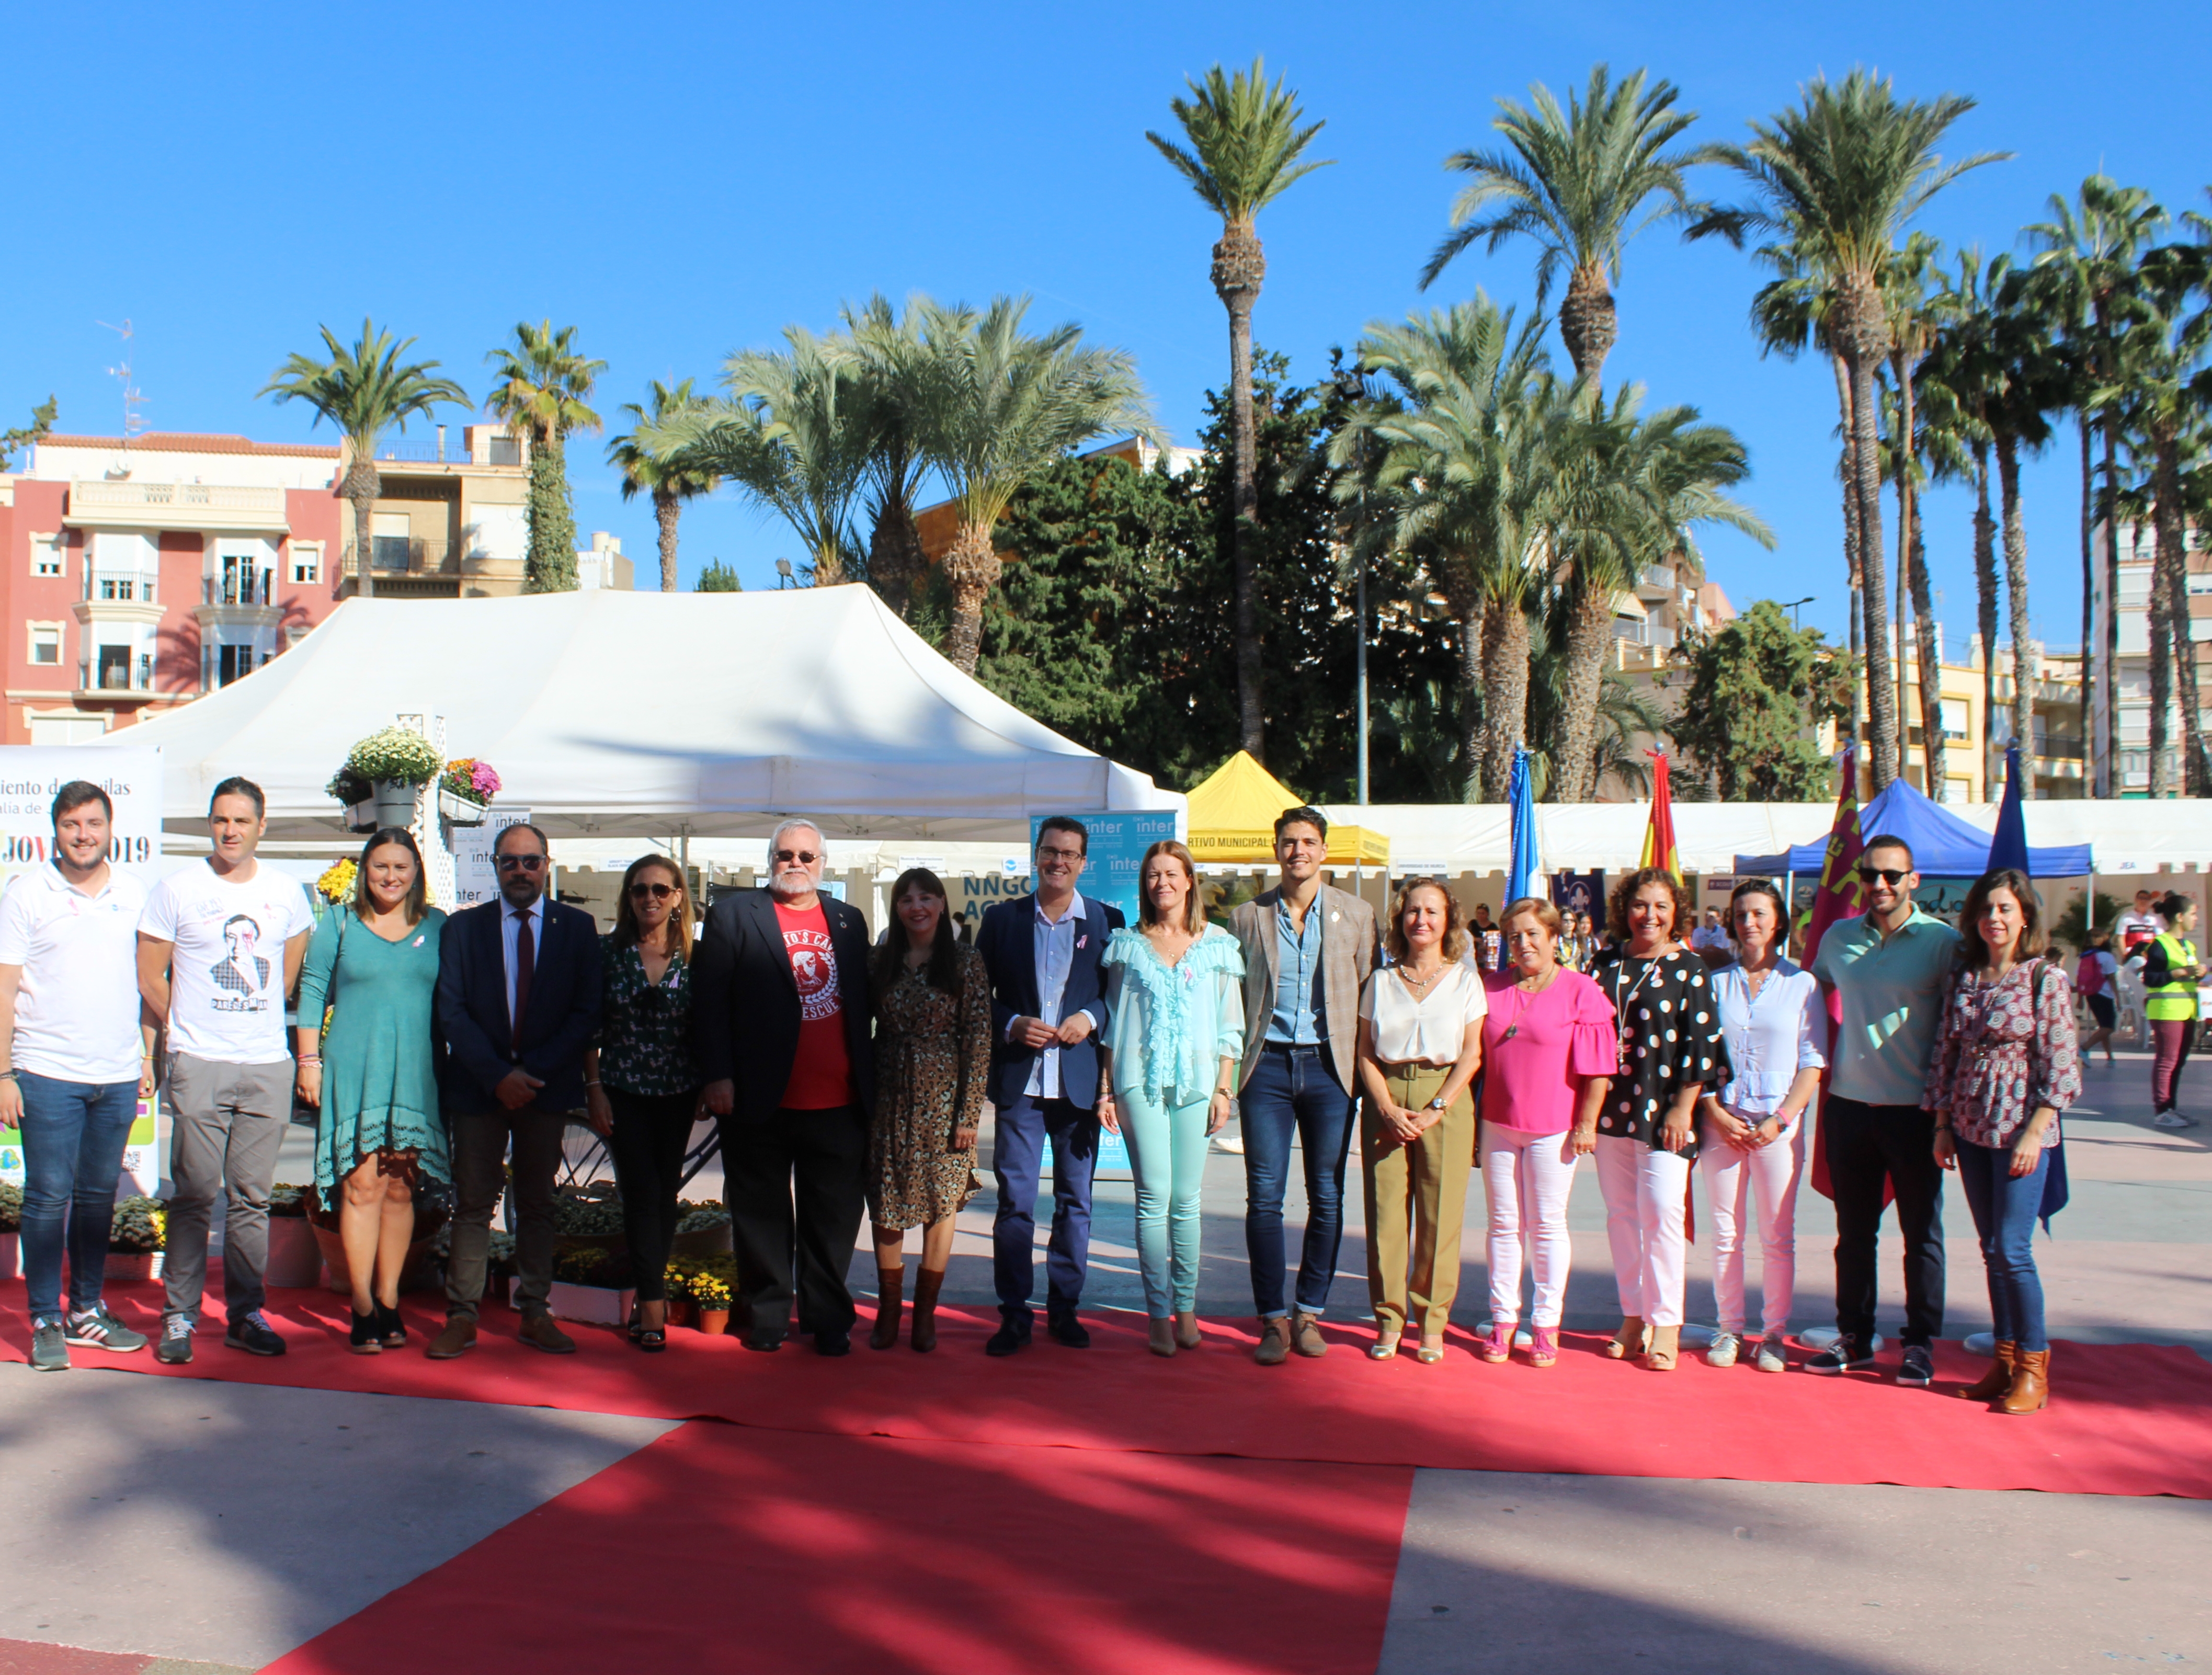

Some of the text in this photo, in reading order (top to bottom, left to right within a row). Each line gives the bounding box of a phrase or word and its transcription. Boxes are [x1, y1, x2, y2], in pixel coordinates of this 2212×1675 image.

[25, 802, 42, 814] de
[1137, 820, 1174, 833] inter
[1218, 837, 1269, 847] MUNICIPAL
[107, 836, 150, 863] 019
[472, 851, 495, 862] inte
[1110, 857, 1139, 871] inte
[802, 998, 839, 1019] ESCUE
[1099, 1133, 1123, 1147] ter
